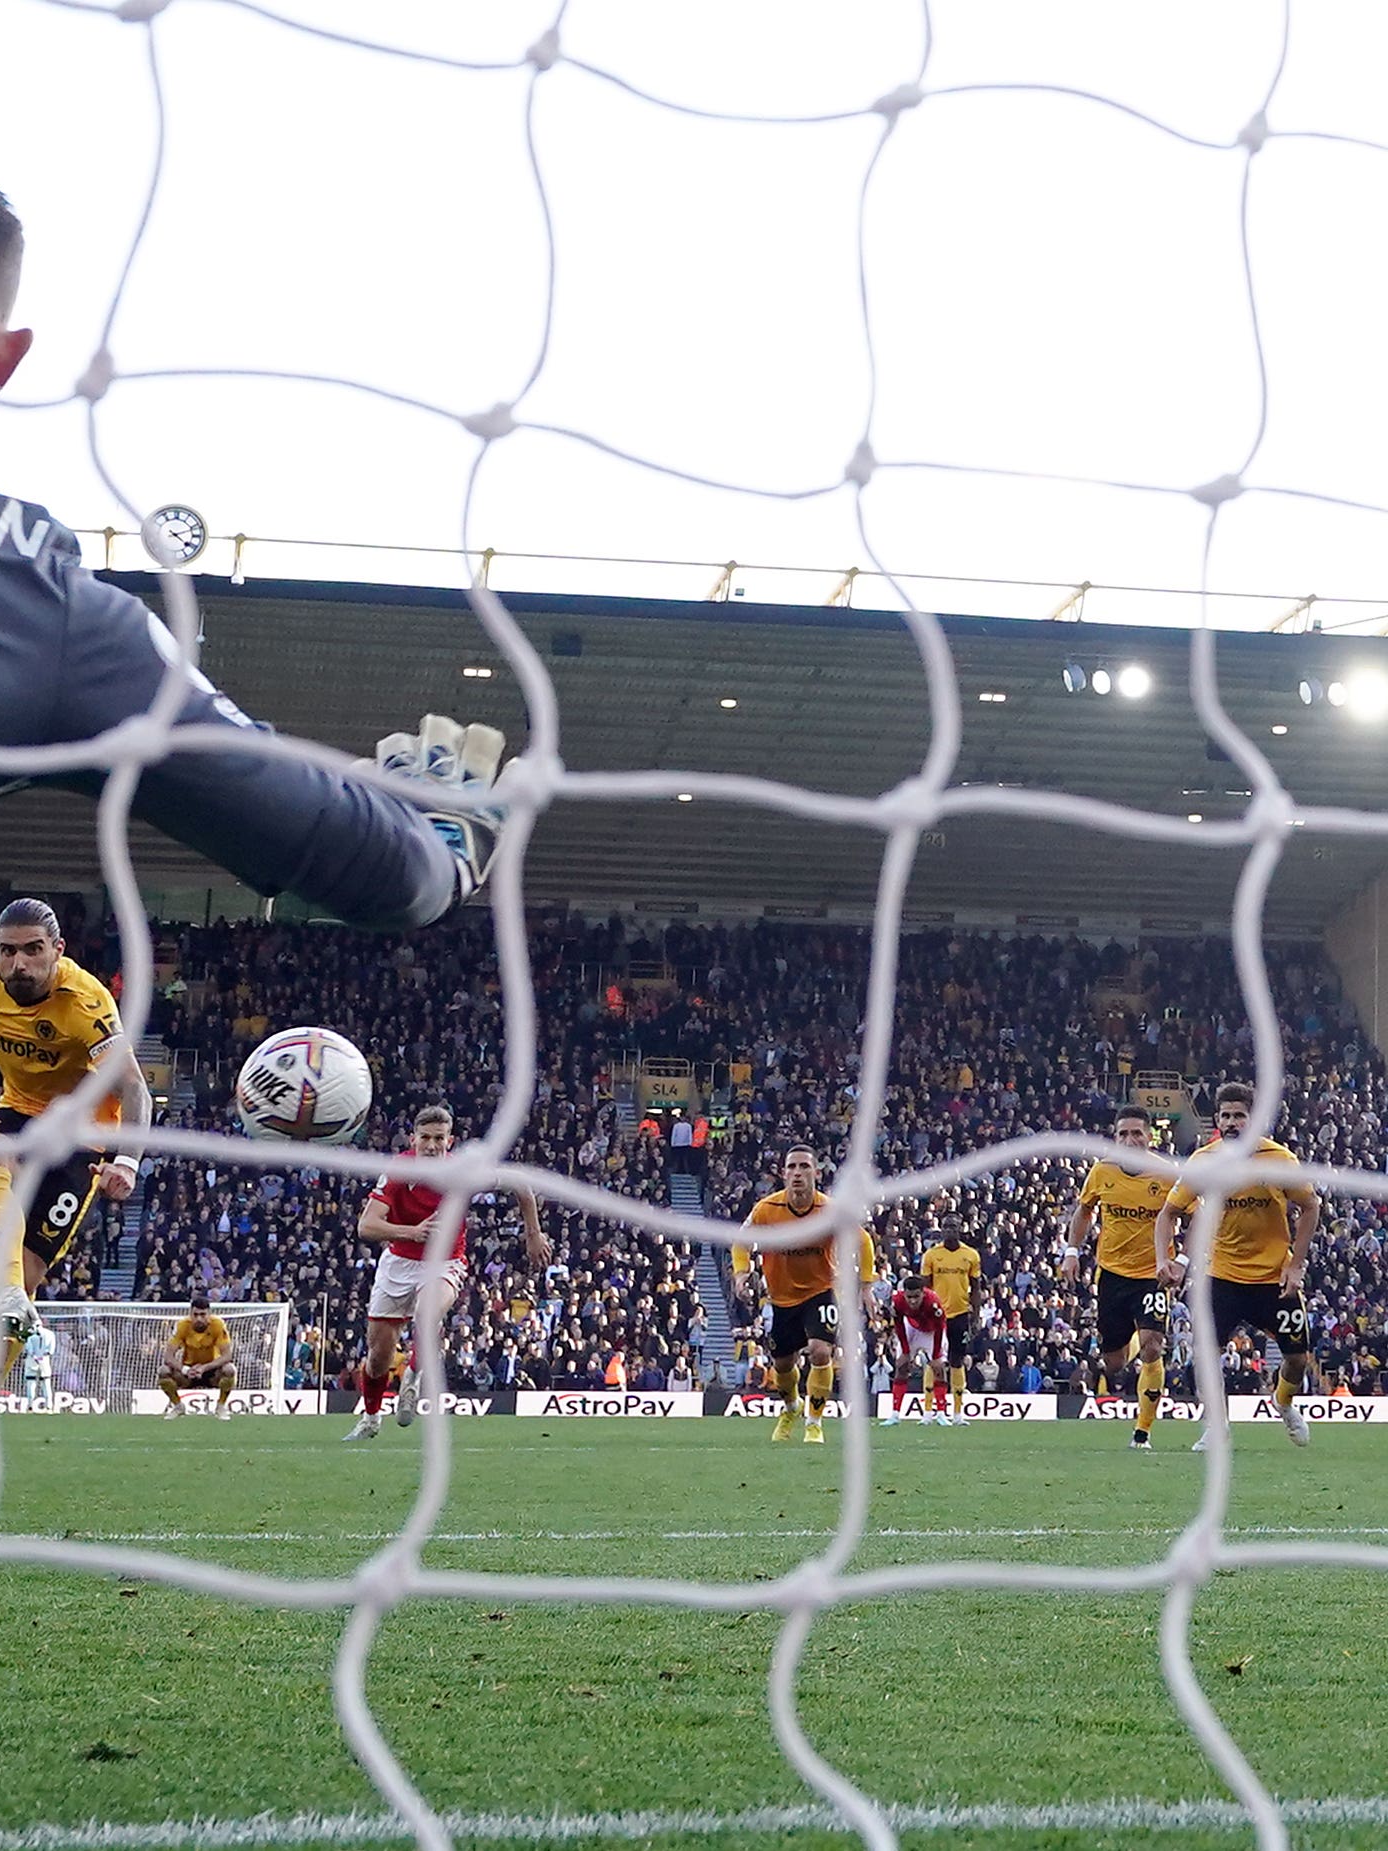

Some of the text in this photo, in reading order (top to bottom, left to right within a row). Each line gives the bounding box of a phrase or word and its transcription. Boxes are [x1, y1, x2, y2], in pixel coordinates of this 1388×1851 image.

[48, 1191, 79, 1228] 8
[818, 1305, 839, 1325] 10
[1142, 1292, 1167, 1315] 28
[1276, 1309, 1305, 1334] 29
[542, 1394, 675, 1416] AstroPay
[1079, 1397, 1205, 1421] AstrPay
[1253, 1399, 1374, 1421] AroPay
